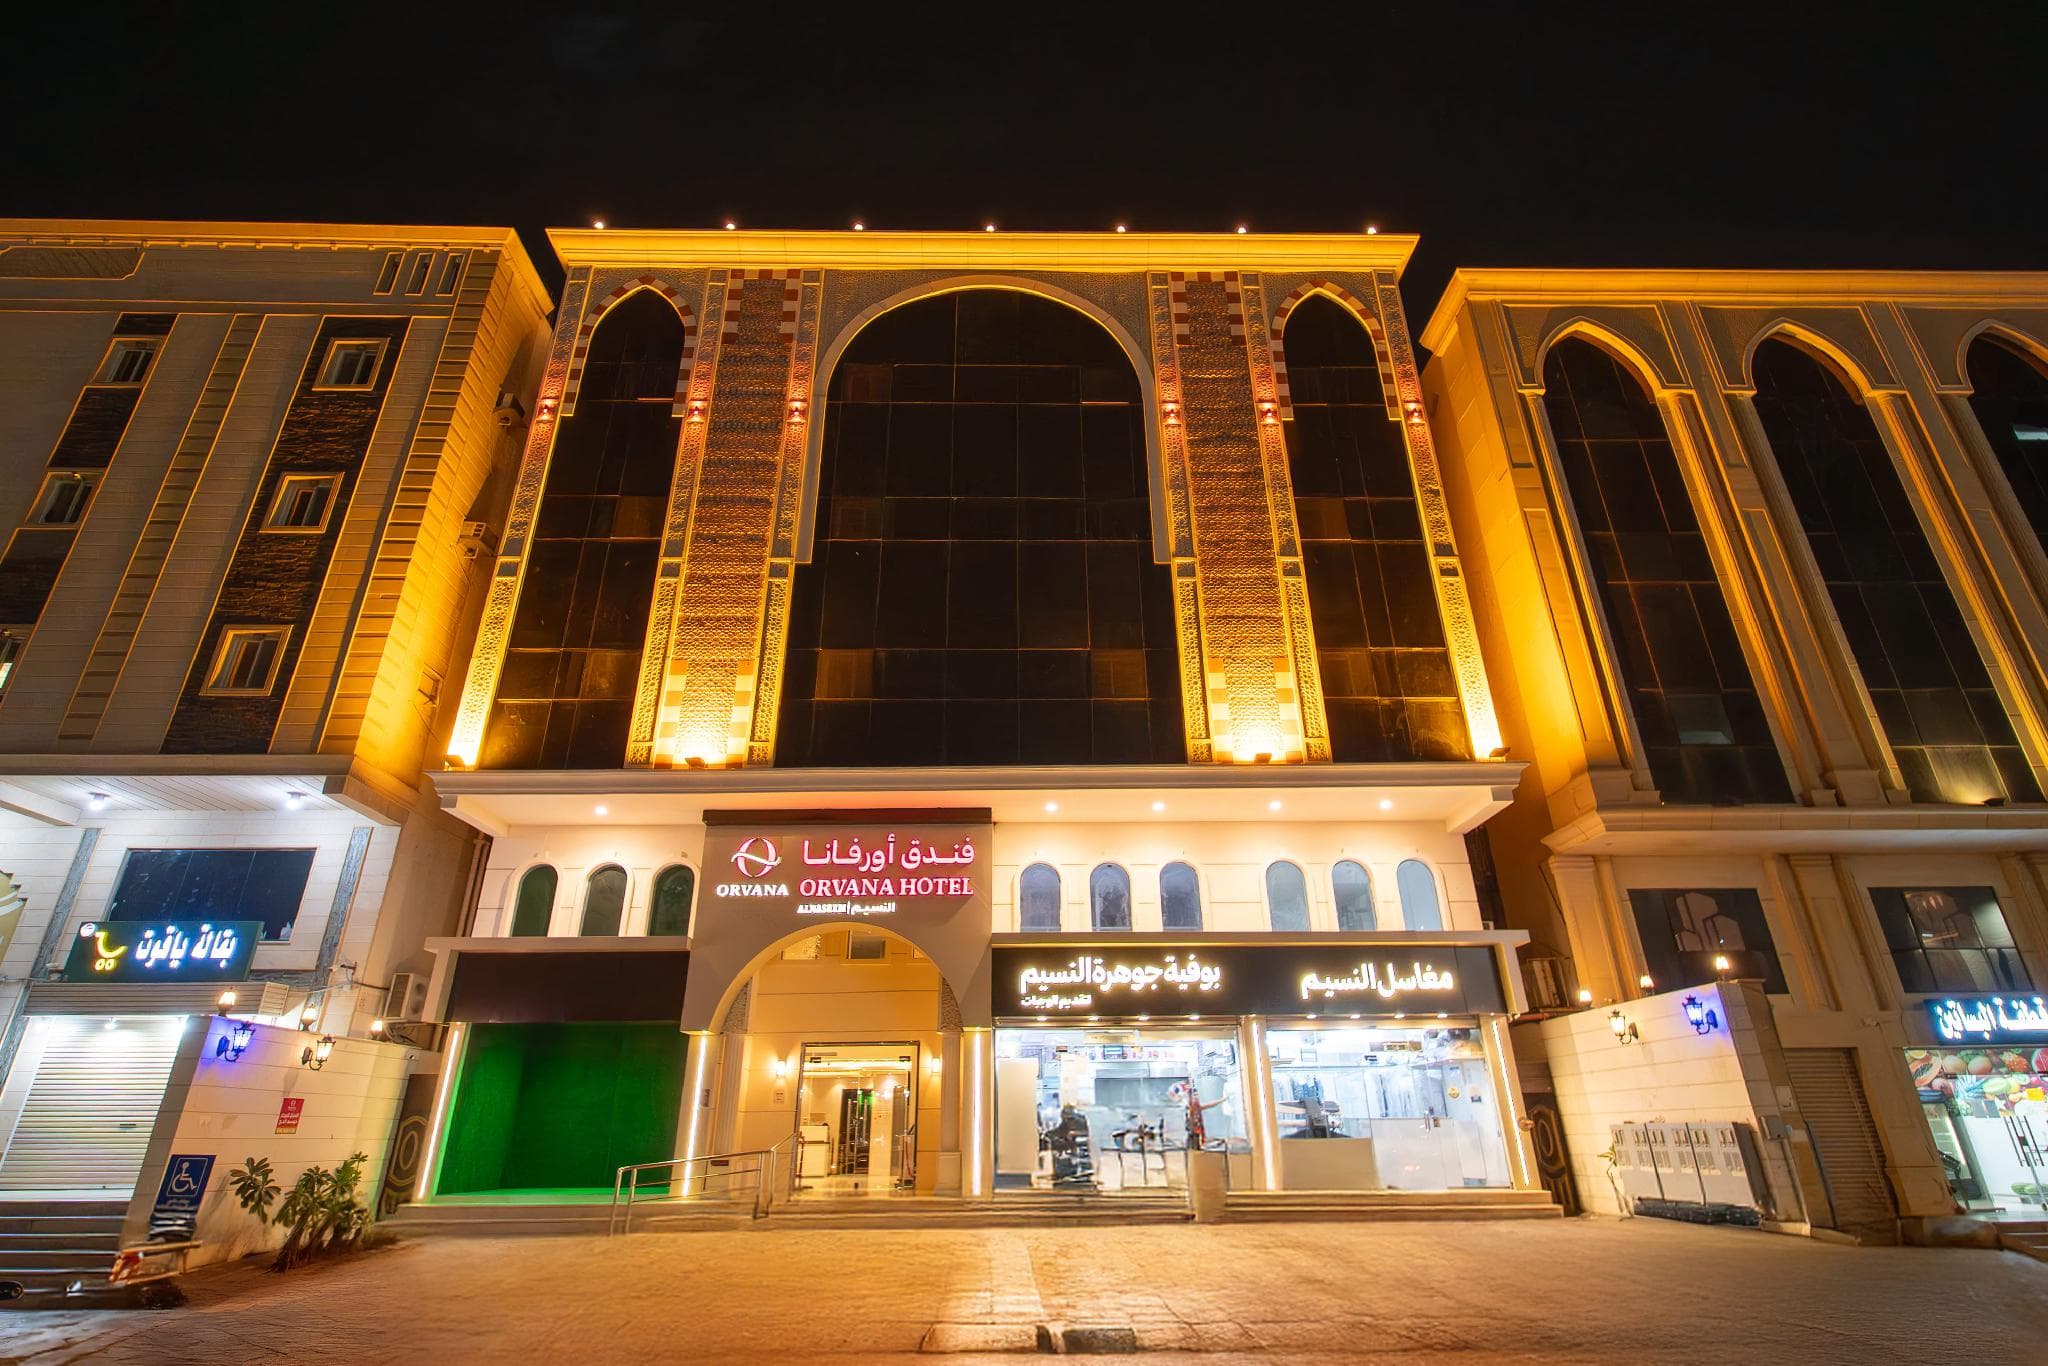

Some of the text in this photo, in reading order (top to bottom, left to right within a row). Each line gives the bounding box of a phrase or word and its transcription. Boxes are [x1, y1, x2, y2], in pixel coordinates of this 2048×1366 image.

[804, 833, 975, 872] فندق أورفانا
[716, 884, 789, 897] ORVANA
[800, 877, 974, 897] ORVANA HOTEL
[851, 902, 896, 915] النسيم
[136, 924, 238, 968] بقالة ياقوت
[1020, 954, 1220, 993] بوفية جوهرة النسيم
[1301, 962, 1454, 999] مغاسل النسيم
[1936, 1000, 1997, 1040] البساتين
